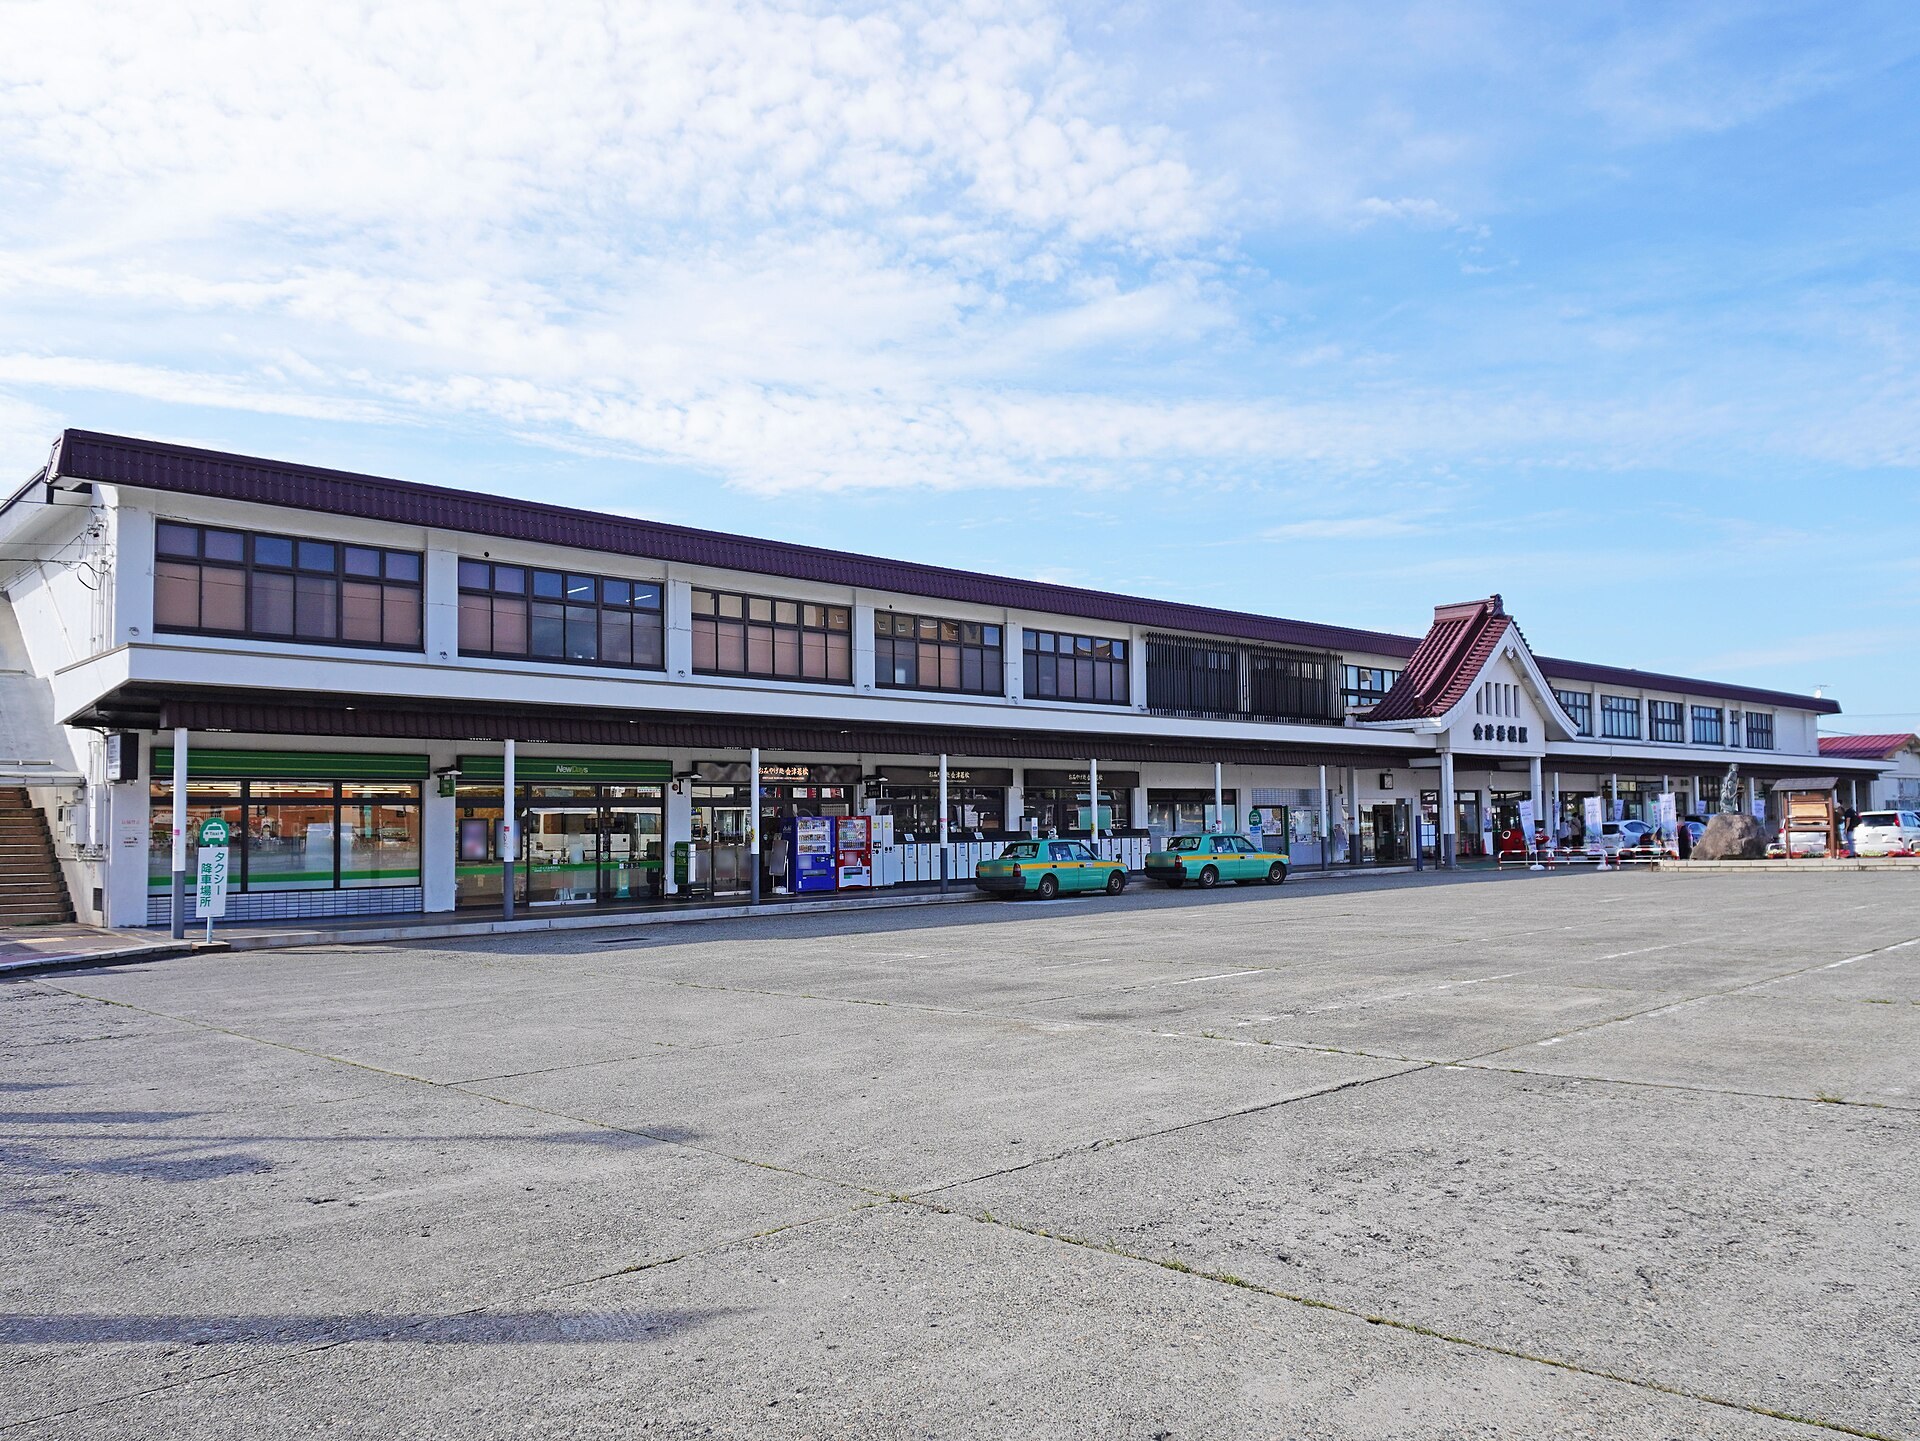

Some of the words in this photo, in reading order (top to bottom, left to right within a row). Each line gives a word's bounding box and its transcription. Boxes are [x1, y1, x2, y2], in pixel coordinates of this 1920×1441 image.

[1472, 722, 1528, 743] 会津若松駅
[555, 765, 589, 775] NewDays
[199, 863, 212, 908] 降車場所
[214, 852, 225, 895] タクシー
